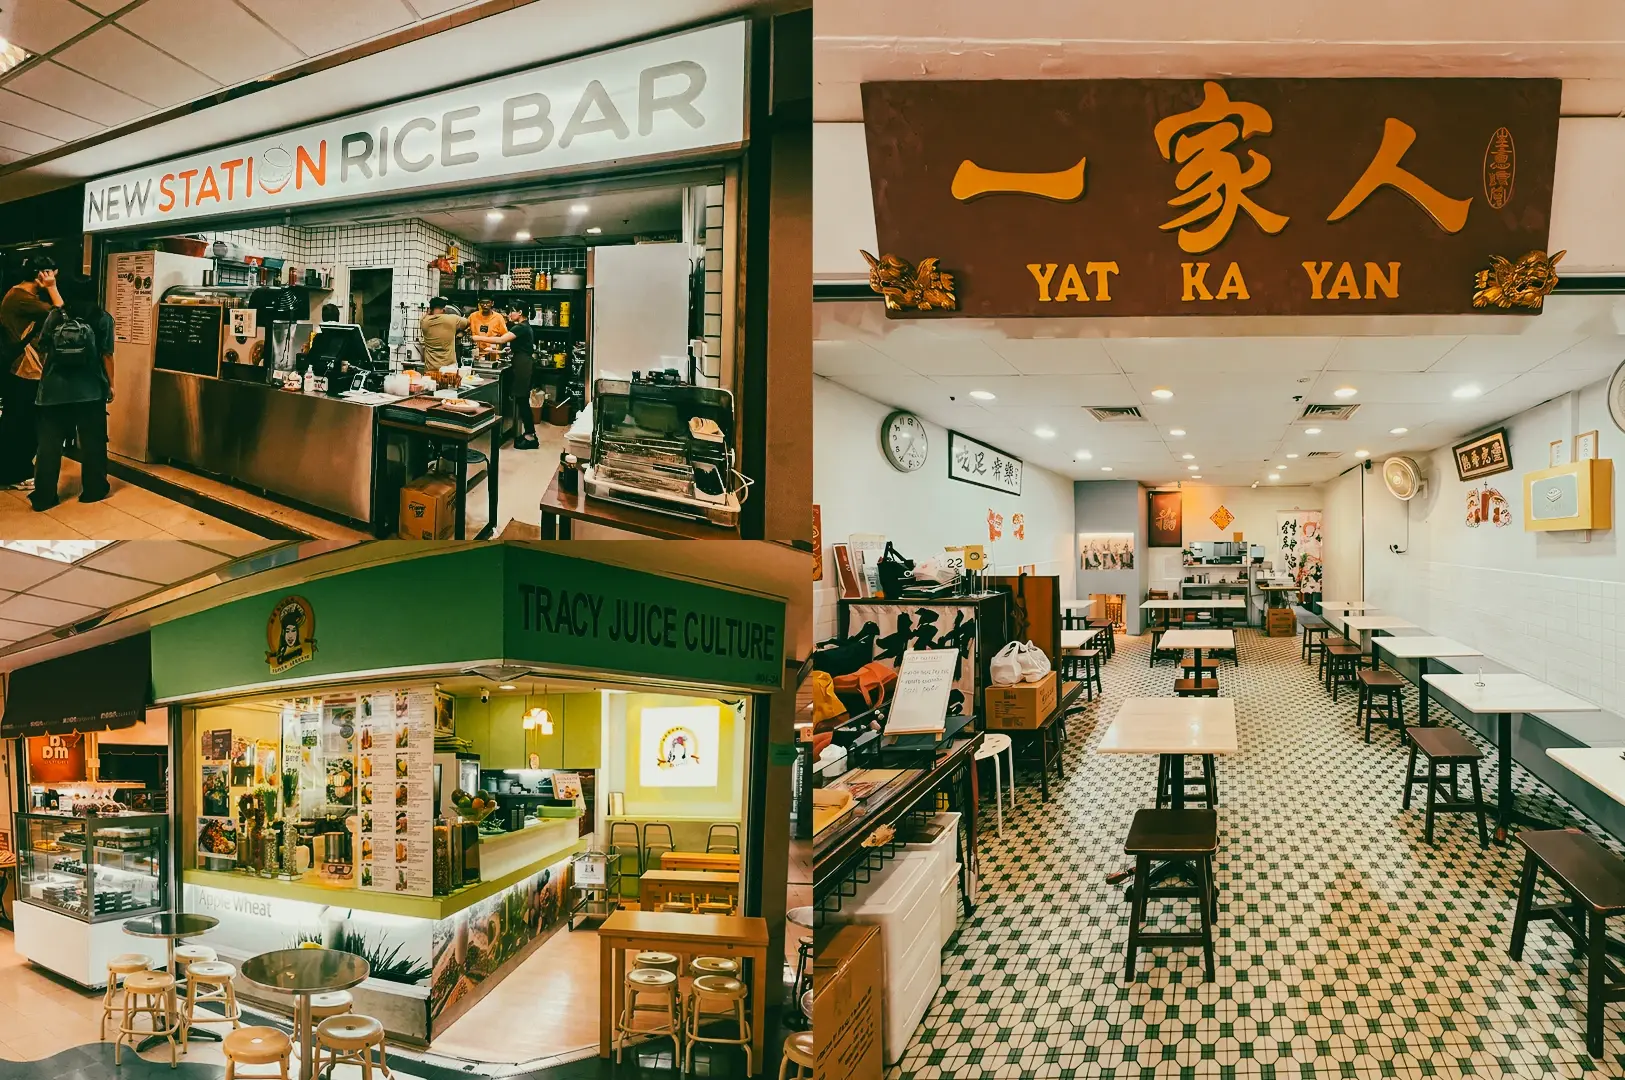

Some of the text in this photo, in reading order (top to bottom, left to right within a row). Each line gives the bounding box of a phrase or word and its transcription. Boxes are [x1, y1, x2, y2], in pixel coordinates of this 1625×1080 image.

[88, 178, 152, 223] NEW
[340, 105, 481, 183] RICE
[502, 60, 707, 158] BAR
[951, 82, 1473, 254] 一家人
[1026, 261, 1402, 302] YAT KA YAN
[947, 557, 963, 568] 22
[518, 583, 776, 662] TRACY JUICE CULTURE
[199, 889, 272, 918] Apple Wheat
